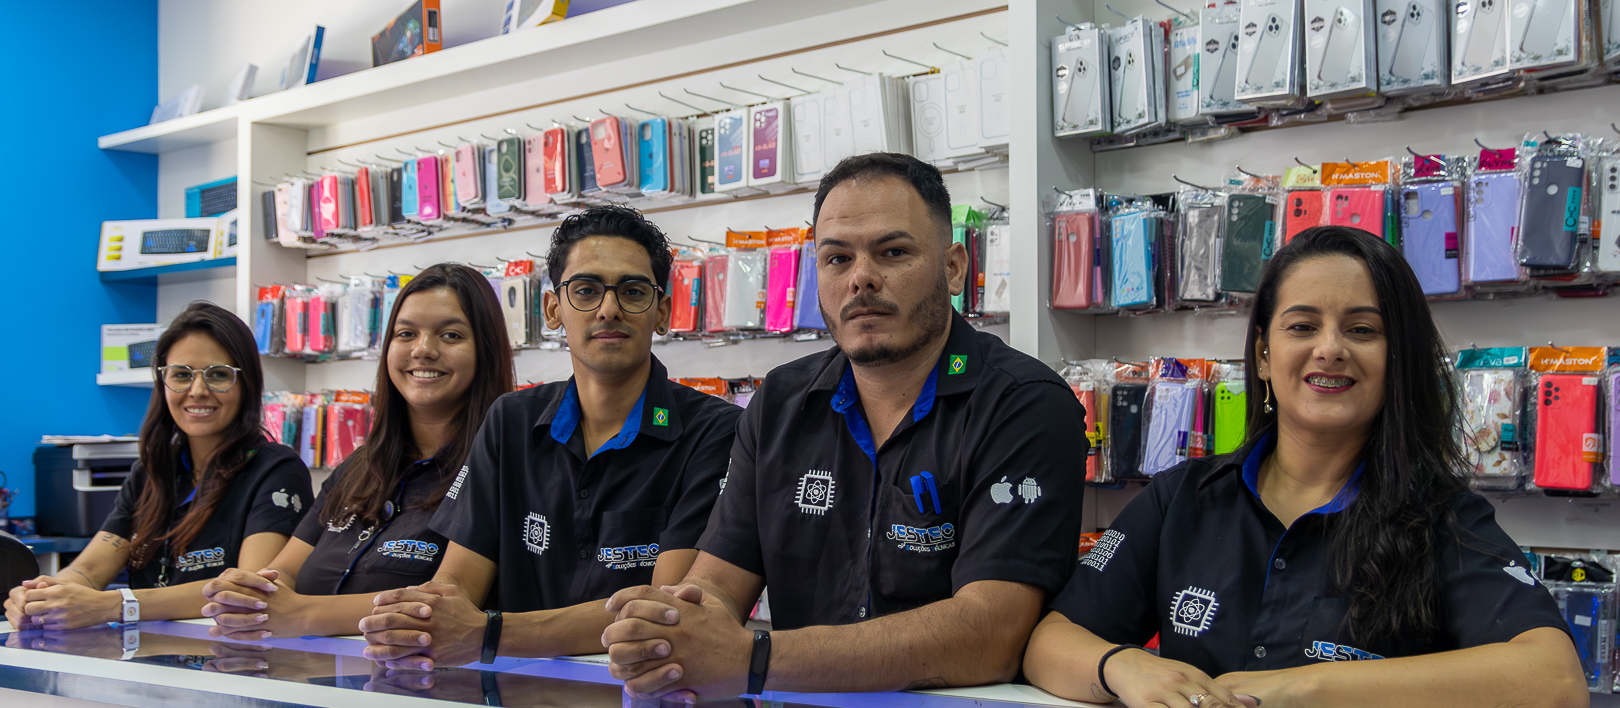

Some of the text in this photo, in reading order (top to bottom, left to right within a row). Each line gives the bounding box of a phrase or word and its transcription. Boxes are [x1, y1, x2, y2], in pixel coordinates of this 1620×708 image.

[886, 522, 955, 544] JESTEC
[377, 539, 439, 555] JESTEC
[597, 543, 660, 561] JESTEC
[1304, 640, 1386, 662] JEST
